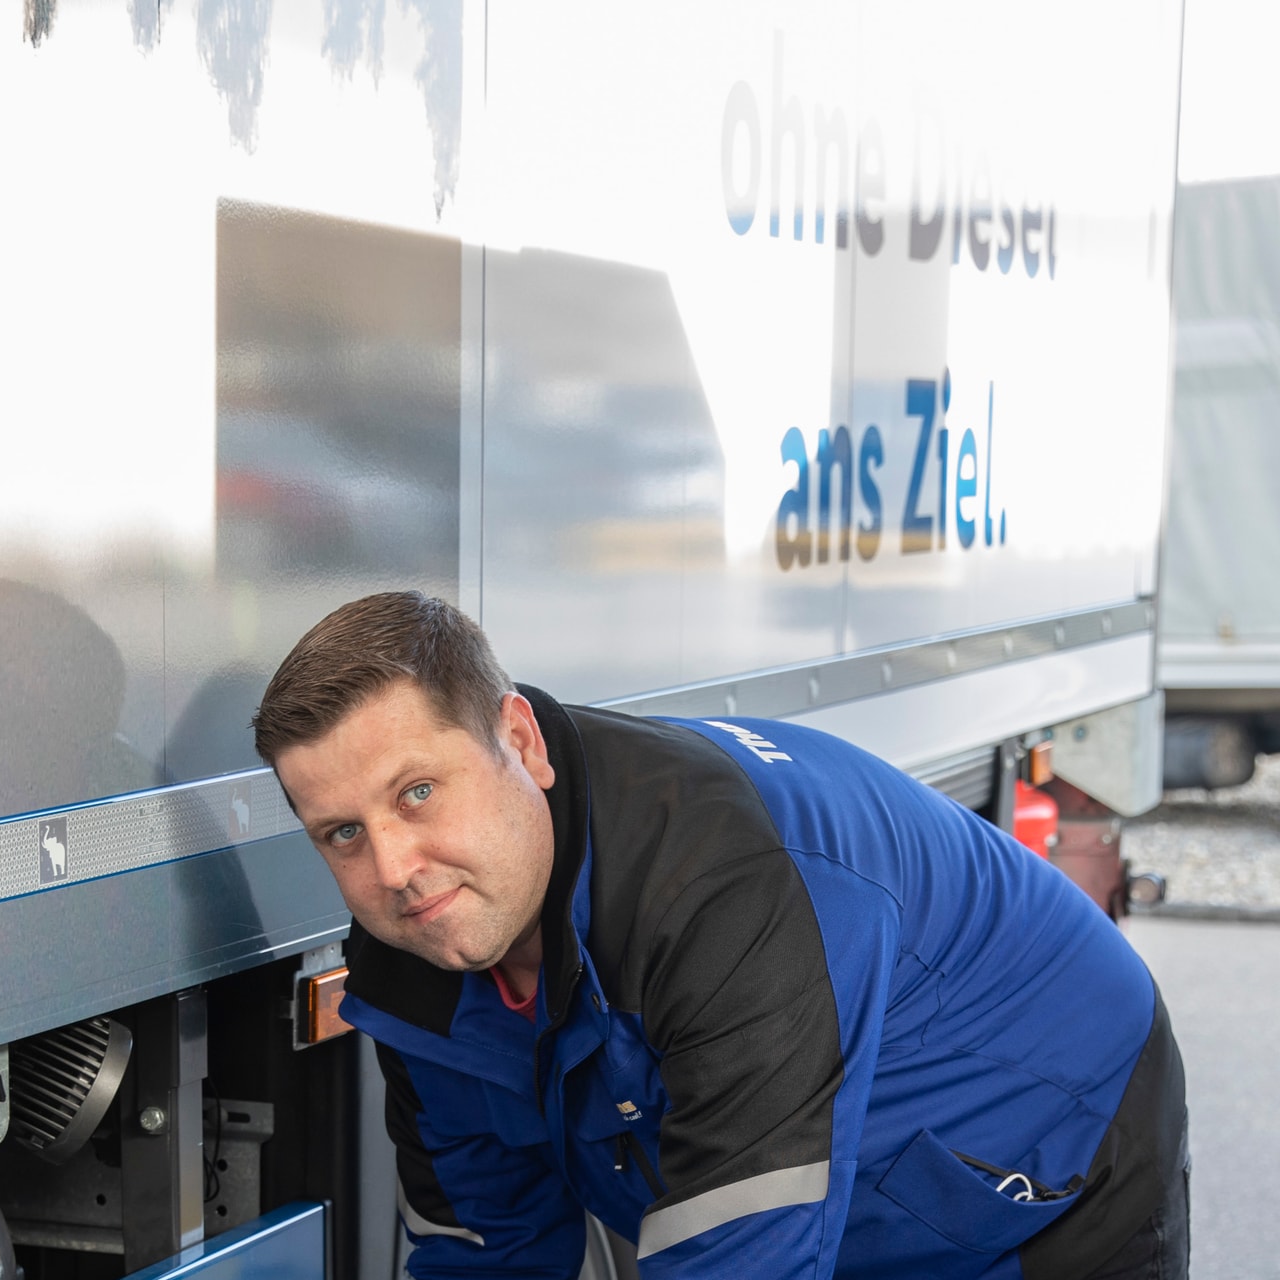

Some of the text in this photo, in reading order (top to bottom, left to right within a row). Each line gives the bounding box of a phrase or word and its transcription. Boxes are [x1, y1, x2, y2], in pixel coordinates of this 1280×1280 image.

[721, 29, 886, 258] ohne
[775, 366, 1008, 573] ans Ziel.
